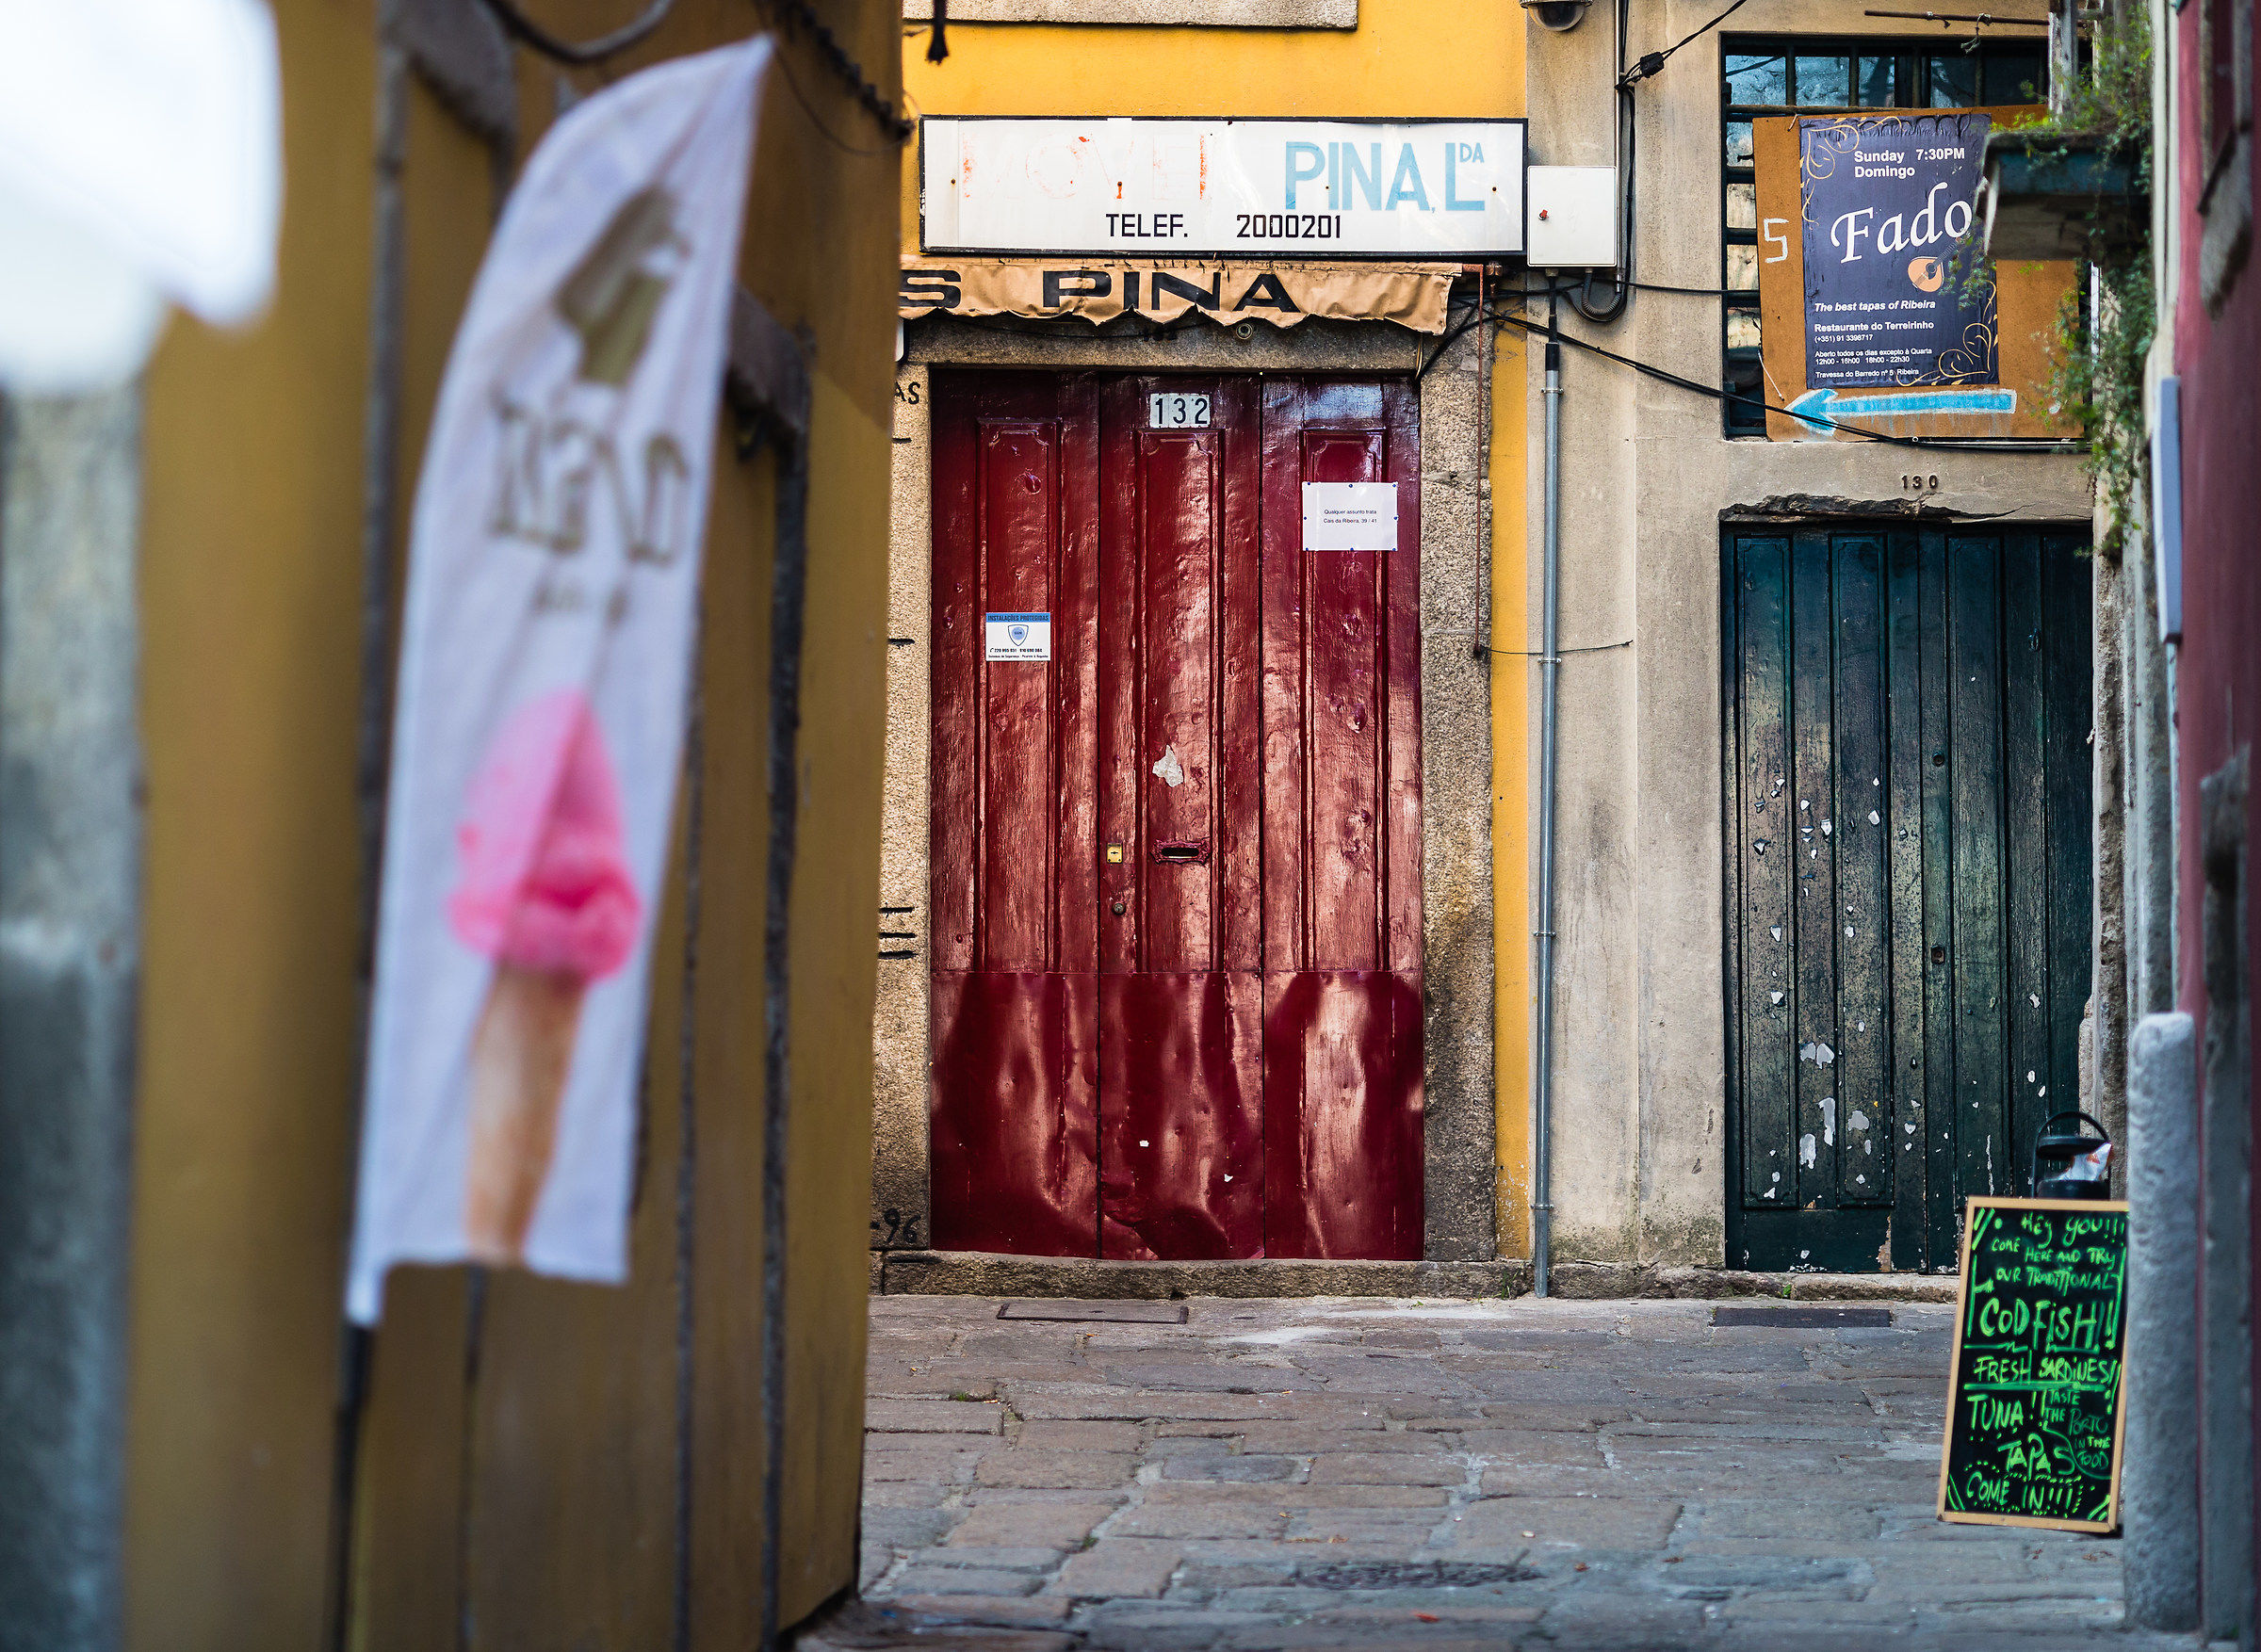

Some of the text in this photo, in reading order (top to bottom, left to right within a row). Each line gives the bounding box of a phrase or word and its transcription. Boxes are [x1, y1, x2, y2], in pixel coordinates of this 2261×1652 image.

[1854, 147, 1966, 165] Sunday 7:30PM
[1854, 166, 1916, 180] Domingo
[1105, 213, 1342, 238] TELEF. 2000201
[1830, 182, 1973, 264] Fado
[1042, 269, 1302, 314] PINA
[1814, 300, 1937, 313] The best tapas of Ribeira
[1814, 320, 1935, 332] Restaurante do Terreirinho
[1879, 349, 1904, 358] excepto
[1911, 348, 1932, 356] Quarta
[1854, 369, 1880, 378] Barredo
[1896, 367, 1919, 376] Ribeira
[1155, 397, 1208, 425] 132
[1901, 475, 1939, 489] 130
[1992, 1238, 2021, 1253] COME
[2025, 1247, 2054, 1262] HERE
[2057, 1249, 2081, 1263] AND
[1996, 1267, 2022, 1283] OUR
[1974, 1350, 2033, 1385] FRESH
[2048, 1389, 2081, 1405] TASTE
[2044, 1407, 2067, 1423] THE
[1997, 1433, 2075, 1482] TAPAS
[1966, 1471, 2010, 1506] COME
